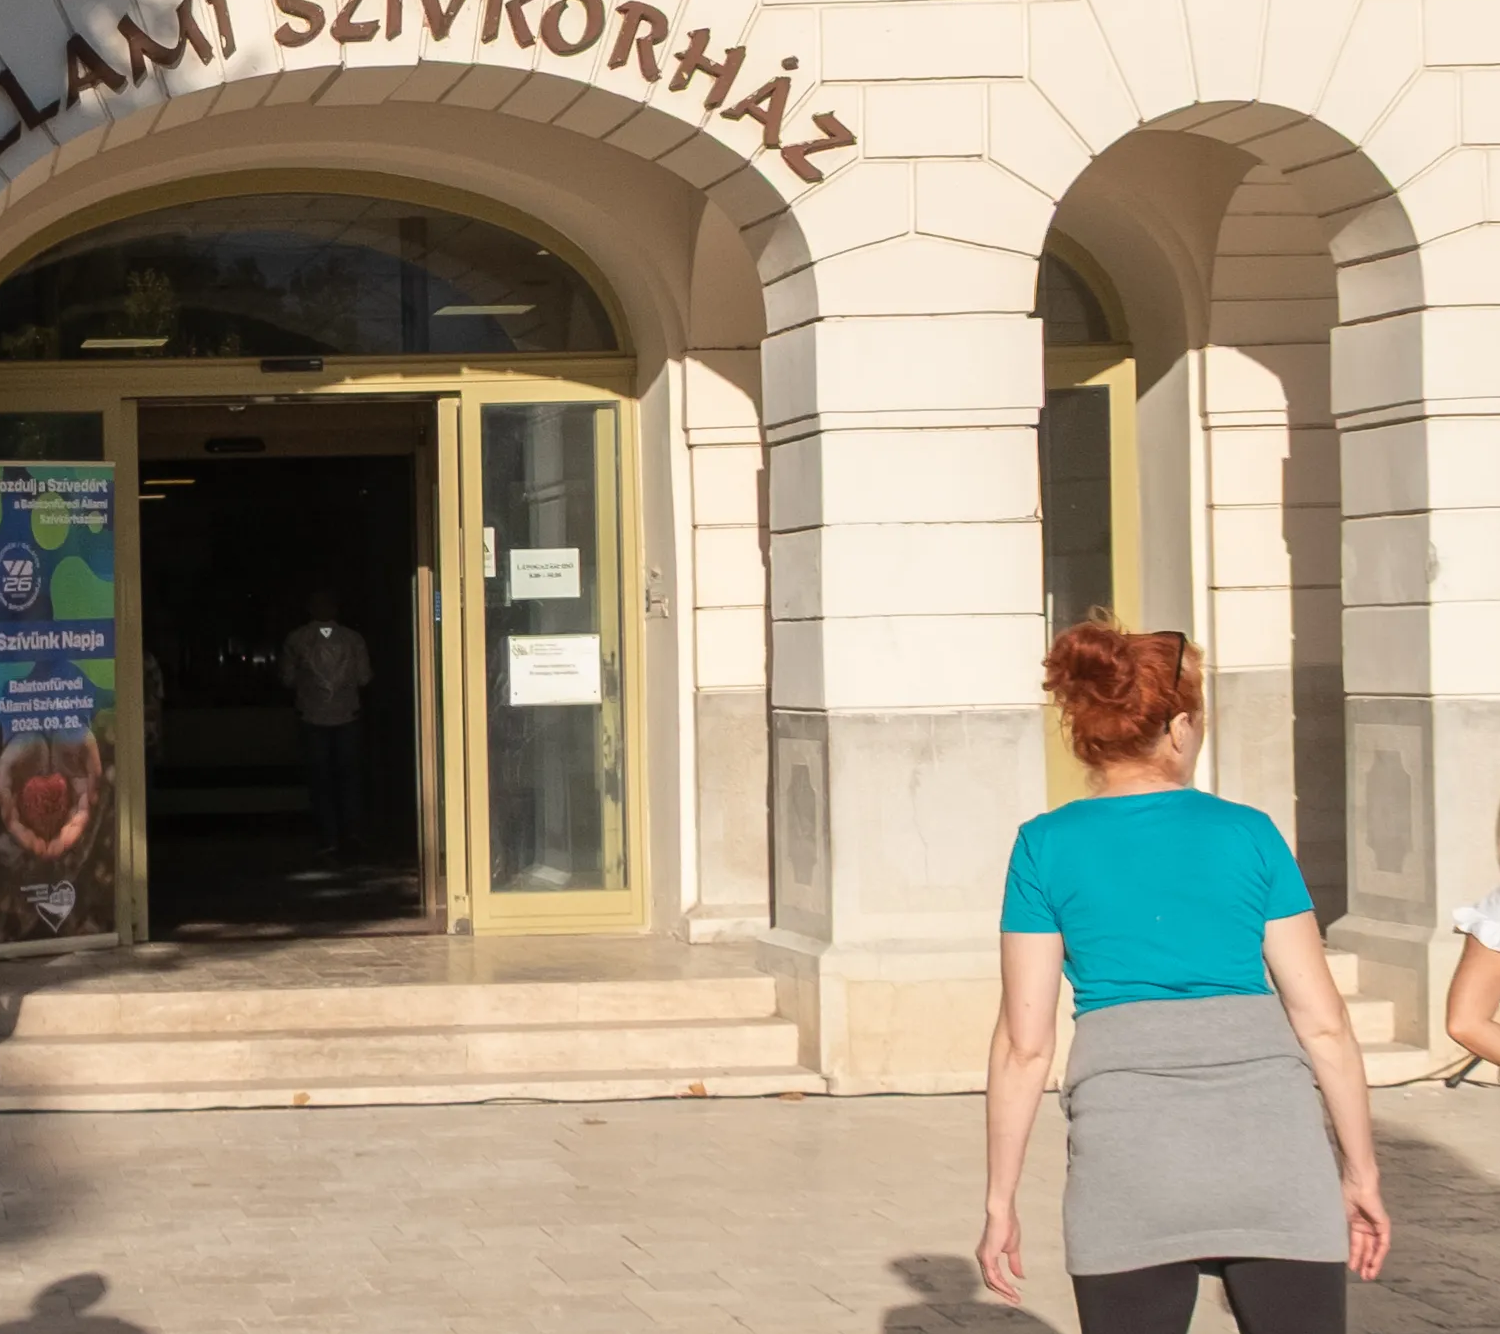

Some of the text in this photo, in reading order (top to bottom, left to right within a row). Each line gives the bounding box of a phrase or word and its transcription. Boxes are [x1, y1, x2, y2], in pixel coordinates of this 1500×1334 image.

[38, 482, 46, 492] a
[62, 629, 105, 652] Napja
[8, 676, 84, 694] Balatonfüredi
[32, 695, 94, 712] Szívkórház
